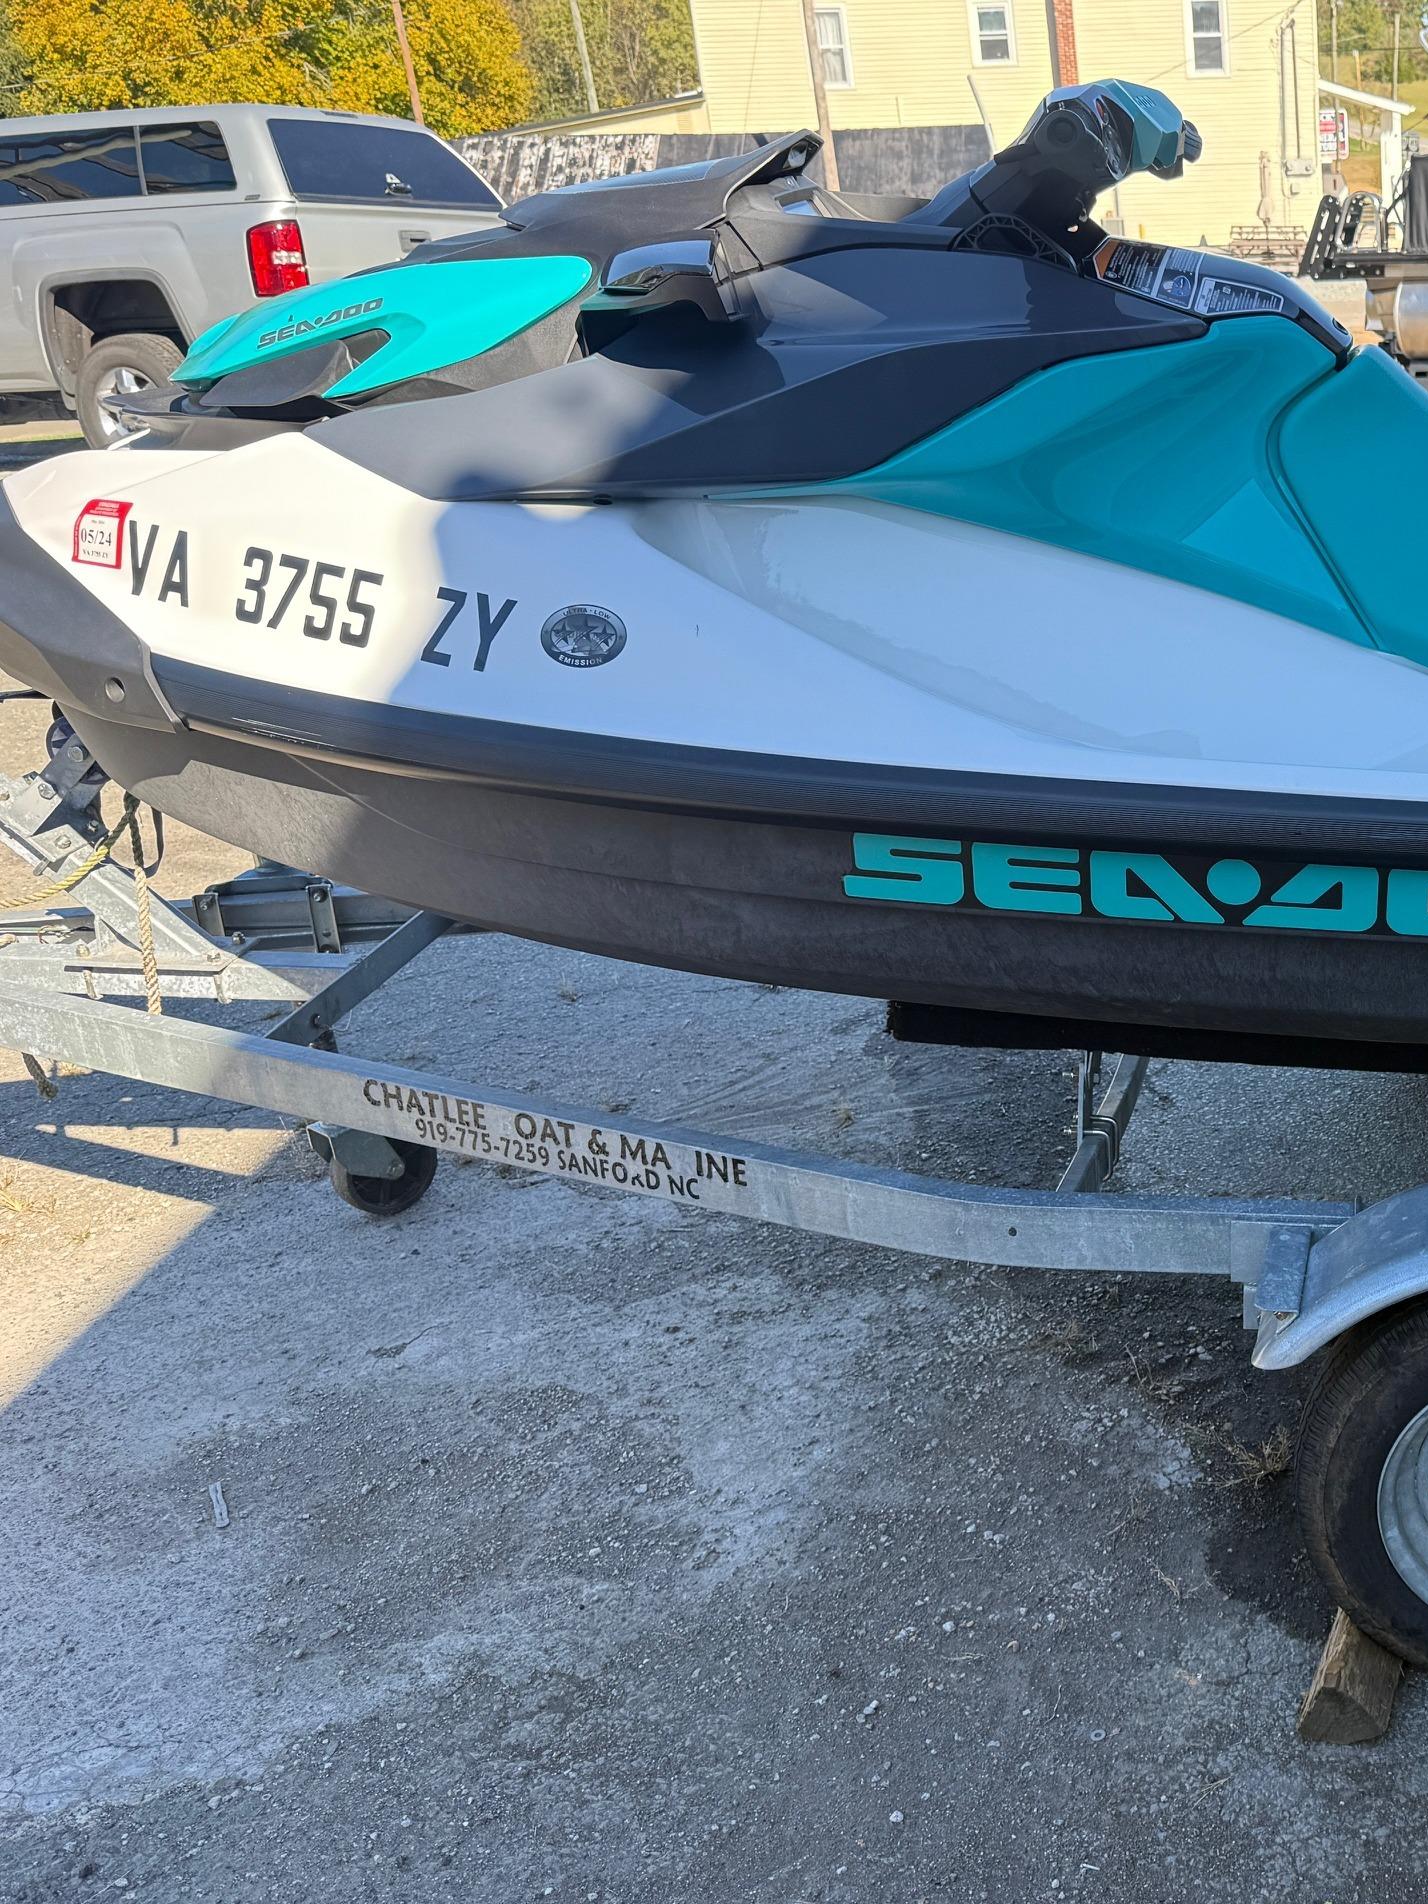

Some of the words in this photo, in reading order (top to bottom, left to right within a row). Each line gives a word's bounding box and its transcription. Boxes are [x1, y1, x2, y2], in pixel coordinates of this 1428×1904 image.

[81, 528, 112, 547] 05/24
[129, 520, 189, 608] VA
[236, 546, 384, 648] 3755
[421, 587, 518, 672] ZY
[558, 654, 603, 666] EMISSION
[363, 1079, 487, 1131] CHATLEE
[588, 1129, 609, 1157] &
[415, 1118, 550, 1167] 919-775-7259
[668, 1174, 700, 1200] NC
